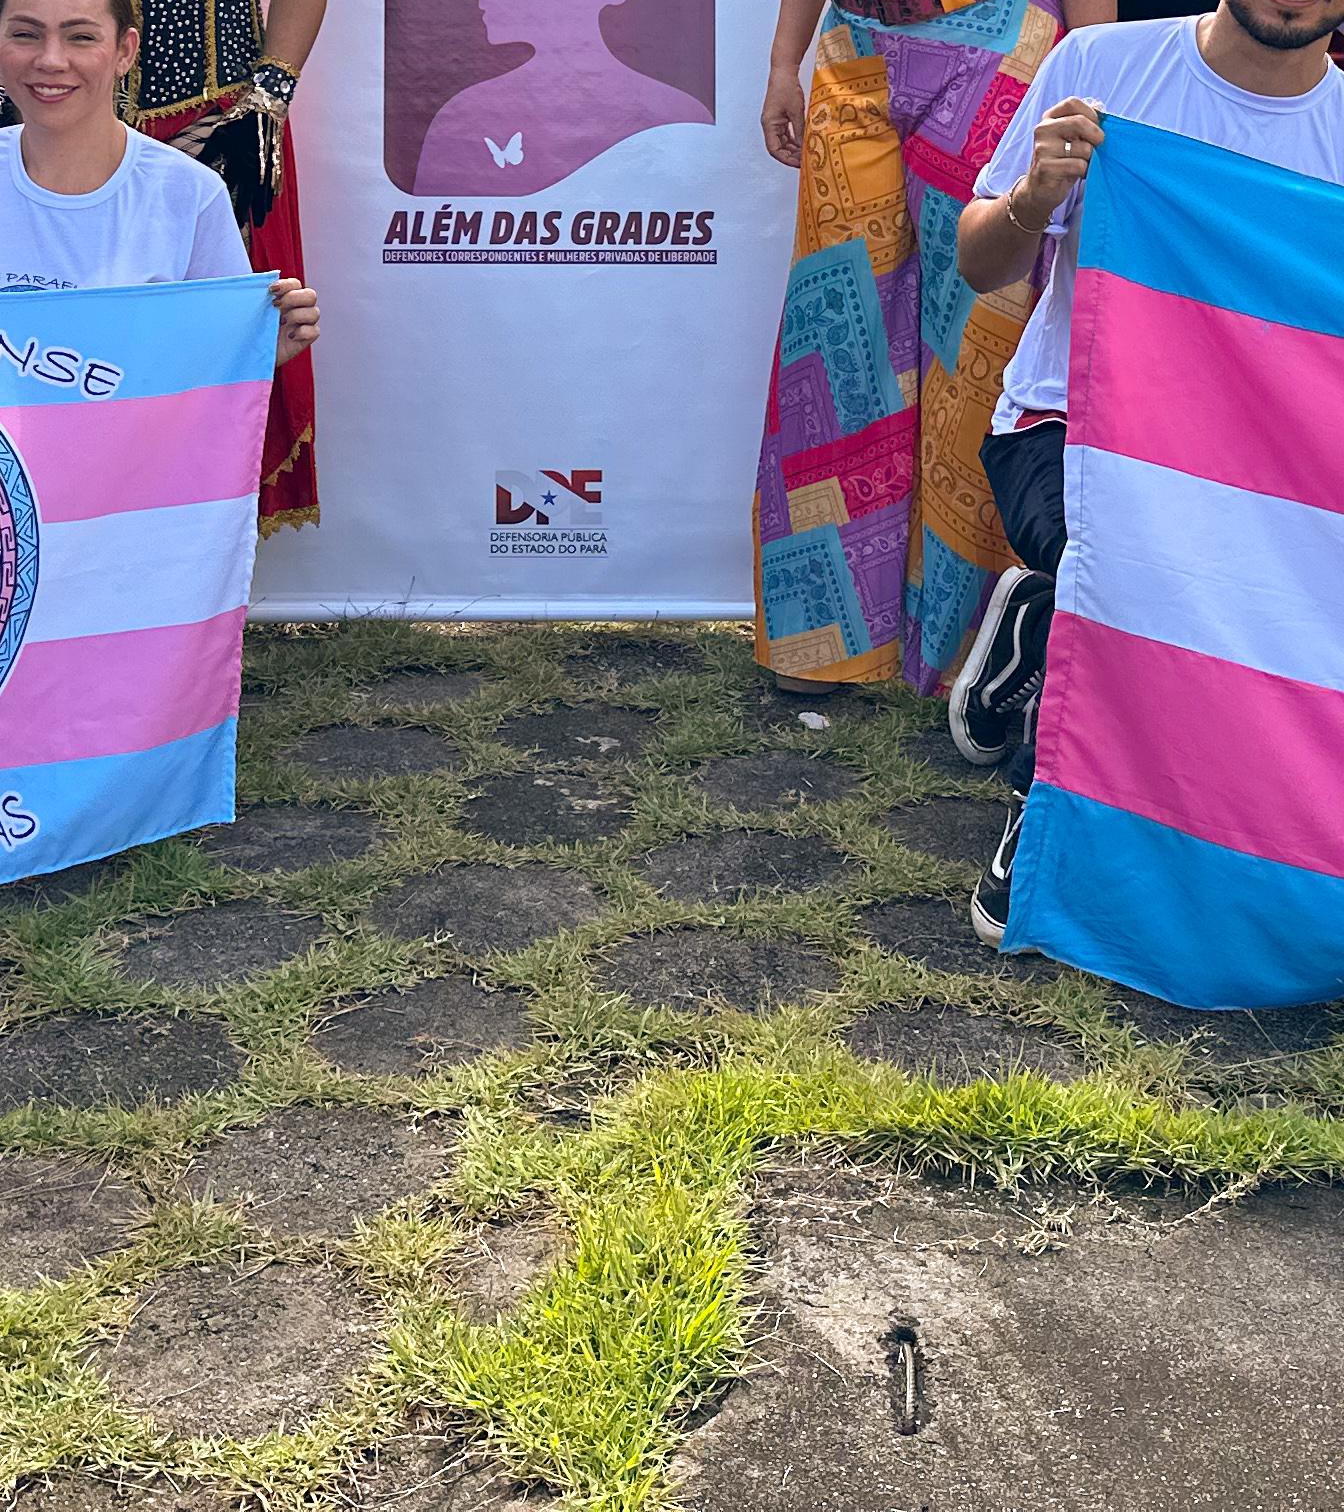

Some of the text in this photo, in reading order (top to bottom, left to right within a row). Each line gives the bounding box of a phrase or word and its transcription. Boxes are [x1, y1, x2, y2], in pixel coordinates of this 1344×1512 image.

[383, 204, 715, 246] ALÉM DAS GRADES
[384, 250, 715, 263] DEFENSORES CORRESPONDENTES E MULHERES PRIVADAS DE LIBERDADE
[6, 272, 78, 290] PARAE
[490, 529, 608, 542] DEFENSORIA PÚBLICA
[490, 542, 608, 554] DO ESTADO DO PARÁ
